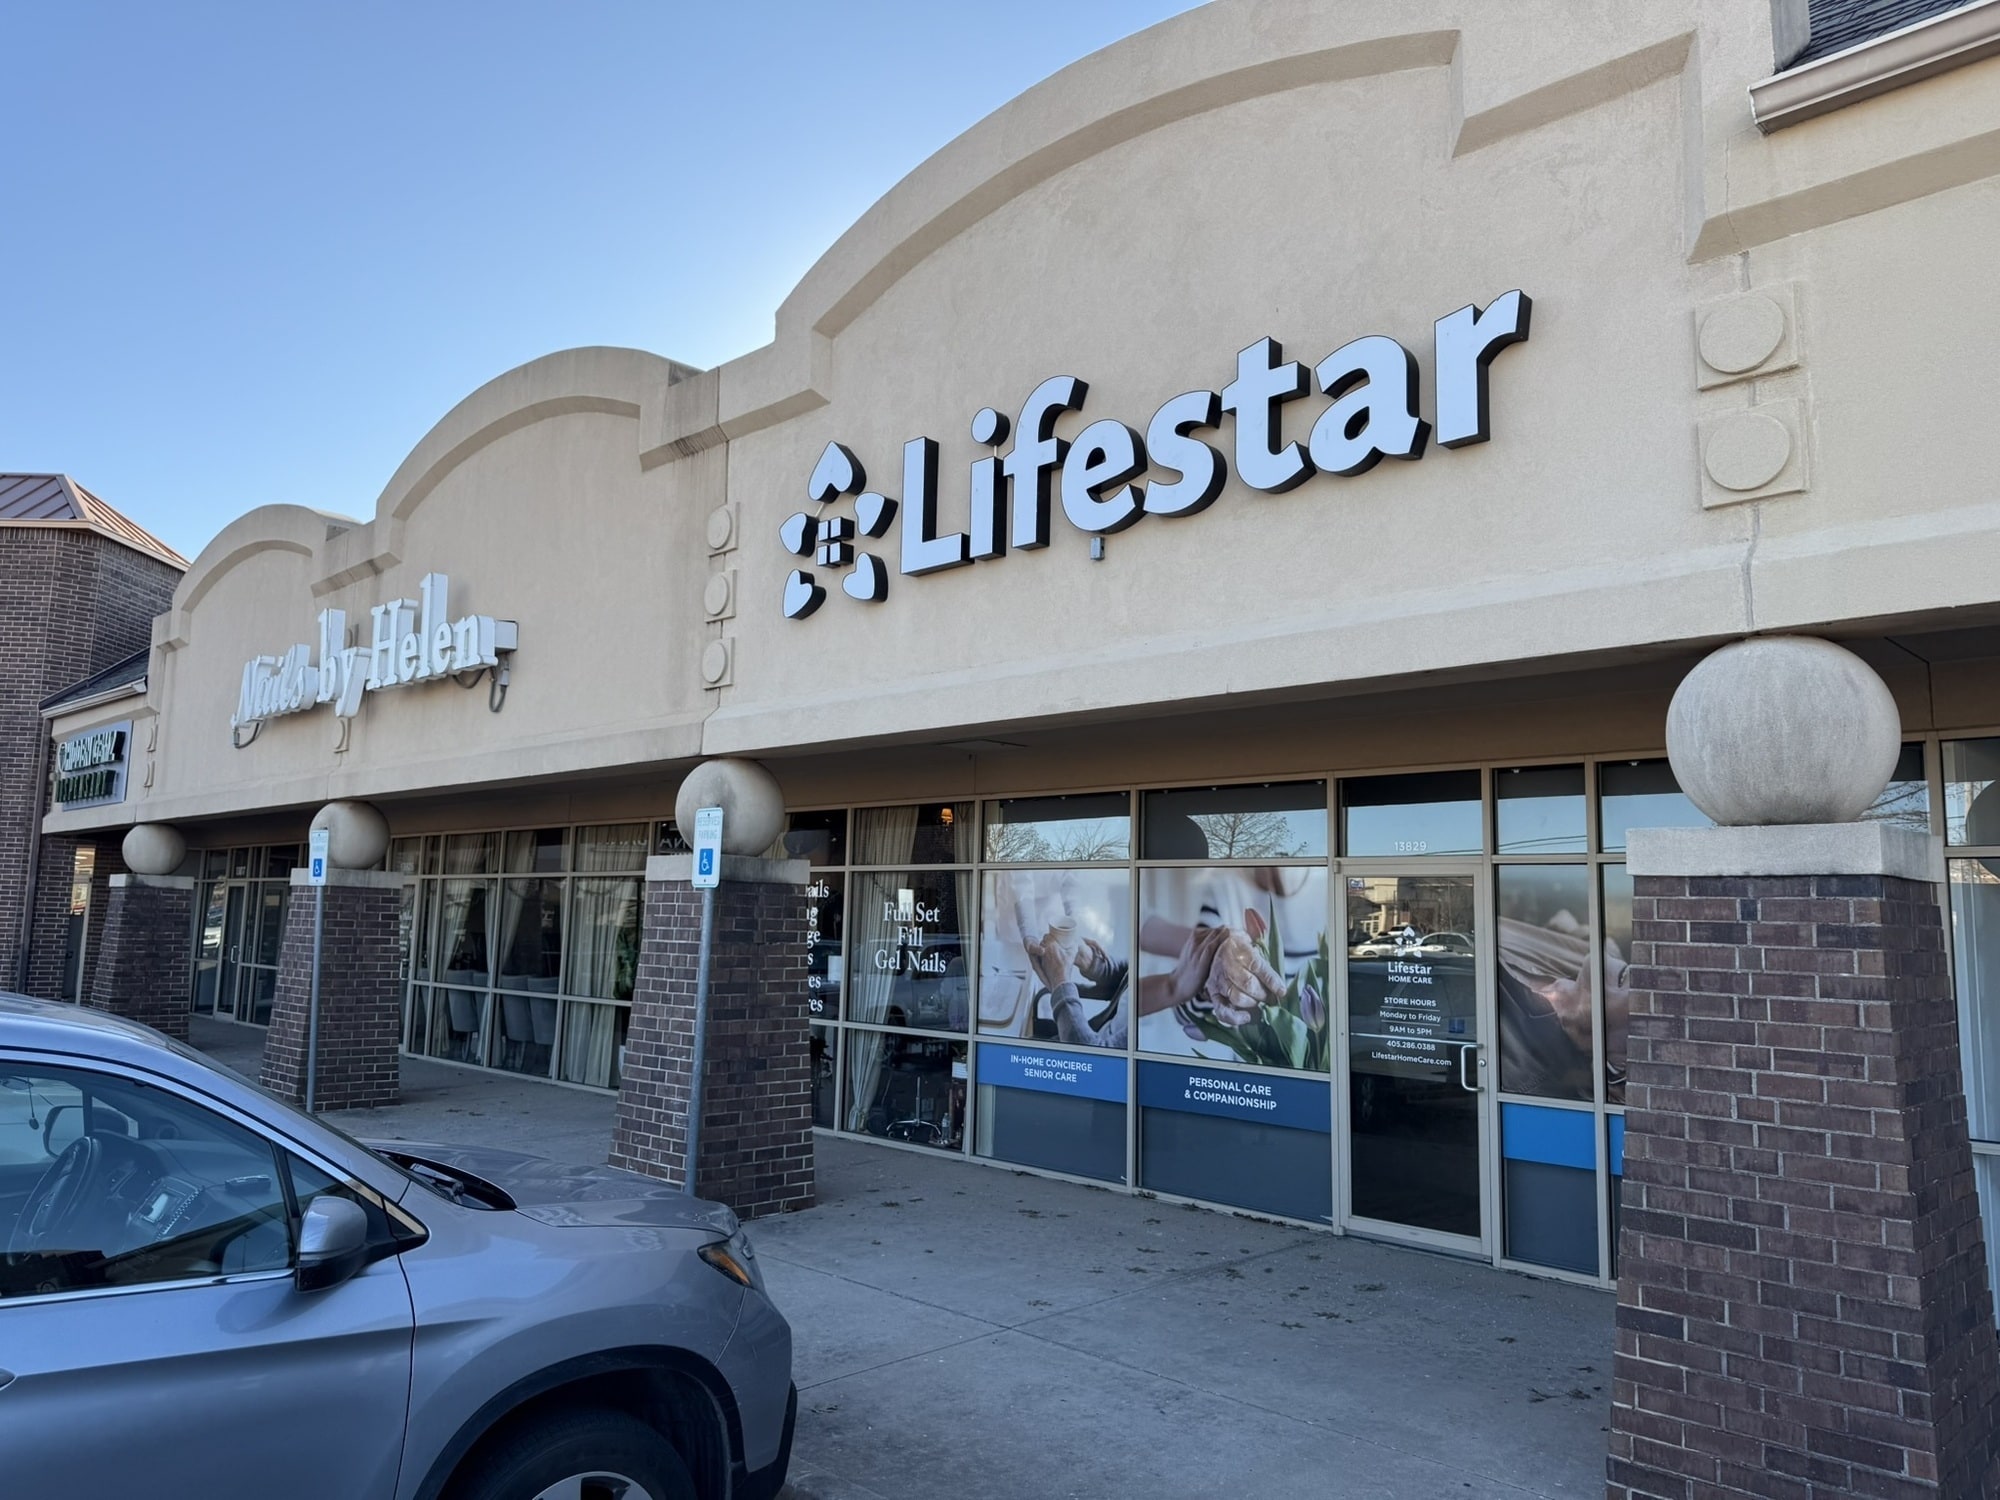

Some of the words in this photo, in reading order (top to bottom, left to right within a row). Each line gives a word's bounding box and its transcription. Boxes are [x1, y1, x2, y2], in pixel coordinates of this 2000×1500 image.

[901, 289, 1532, 577] Lifestar
[230, 643, 318, 728] Nails
[317, 608, 371, 717] by
[366, 572, 498, 691] Helen
[1393, 840, 1428, 852] 13829
[806, 879, 829, 898] ails
[883, 901, 913, 922] Full
[915, 901, 940, 923] Set
[897, 926, 923, 947] Fill
[875, 949, 901, 970] Gel
[907, 950, 946, 973] Nails
[1387, 961, 1433, 975] Lifestar
[1388, 975, 1411, 983] HOME
[1412, 976, 1433, 985] CARE
[1384, 997, 1408, 1005] STORE
[1410, 999, 1437, 1007] HOURS
[1380, 1010, 1407, 1021] Monday
[1408, 1012, 1417, 1020] to
[1418, 1013, 1441, 1023] Friday
[1389, 1025, 1406, 1033] 9AM
[1407, 1026, 1415, 1034] to
[1416, 1028, 1432, 1036] 5PM
[1386, 1040, 1436, 1051] 405.286.0388
[1010, 1054, 1044, 1067] IN-HOME
[1045, 1058, 1093, 1073] CONCIERGE
[1371, 1051, 1452, 1066] LifestarHomeCare.com
[1024, 1067, 1053, 1080] SENIOR
[1054, 1072, 1077, 1083] CARE
[1189, 1076, 1241, 1092] PERSONAL
[1243, 1083, 1272, 1096] CARE
[1184, 1089, 1191, 1099] &
[1193, 1090, 1277, 1111] COMPANIONSHIP
